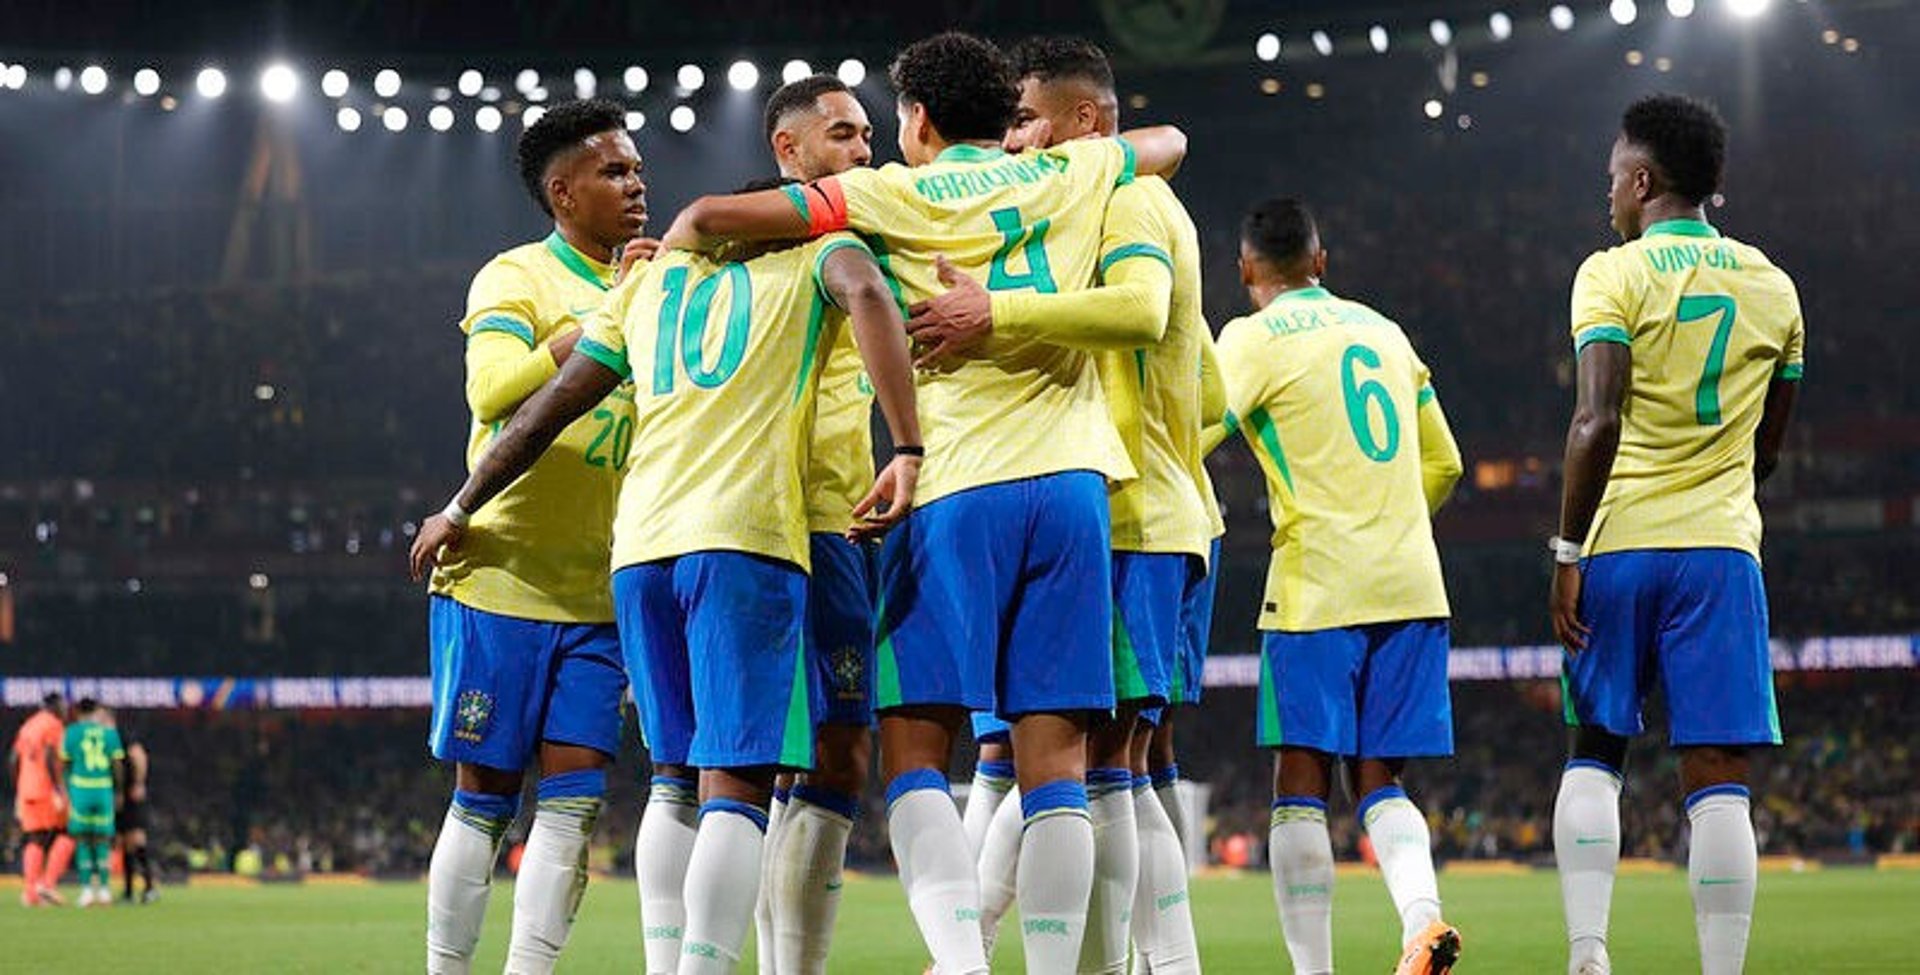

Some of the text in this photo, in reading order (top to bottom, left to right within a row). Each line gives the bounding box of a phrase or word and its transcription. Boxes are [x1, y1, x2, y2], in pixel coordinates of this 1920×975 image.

[986, 206, 1058, 294] 4
[652, 260, 752, 397] 10
[1676, 294, 1738, 426] 7
[584, 408, 634, 471] 20
[1340, 344, 1400, 463] 6
